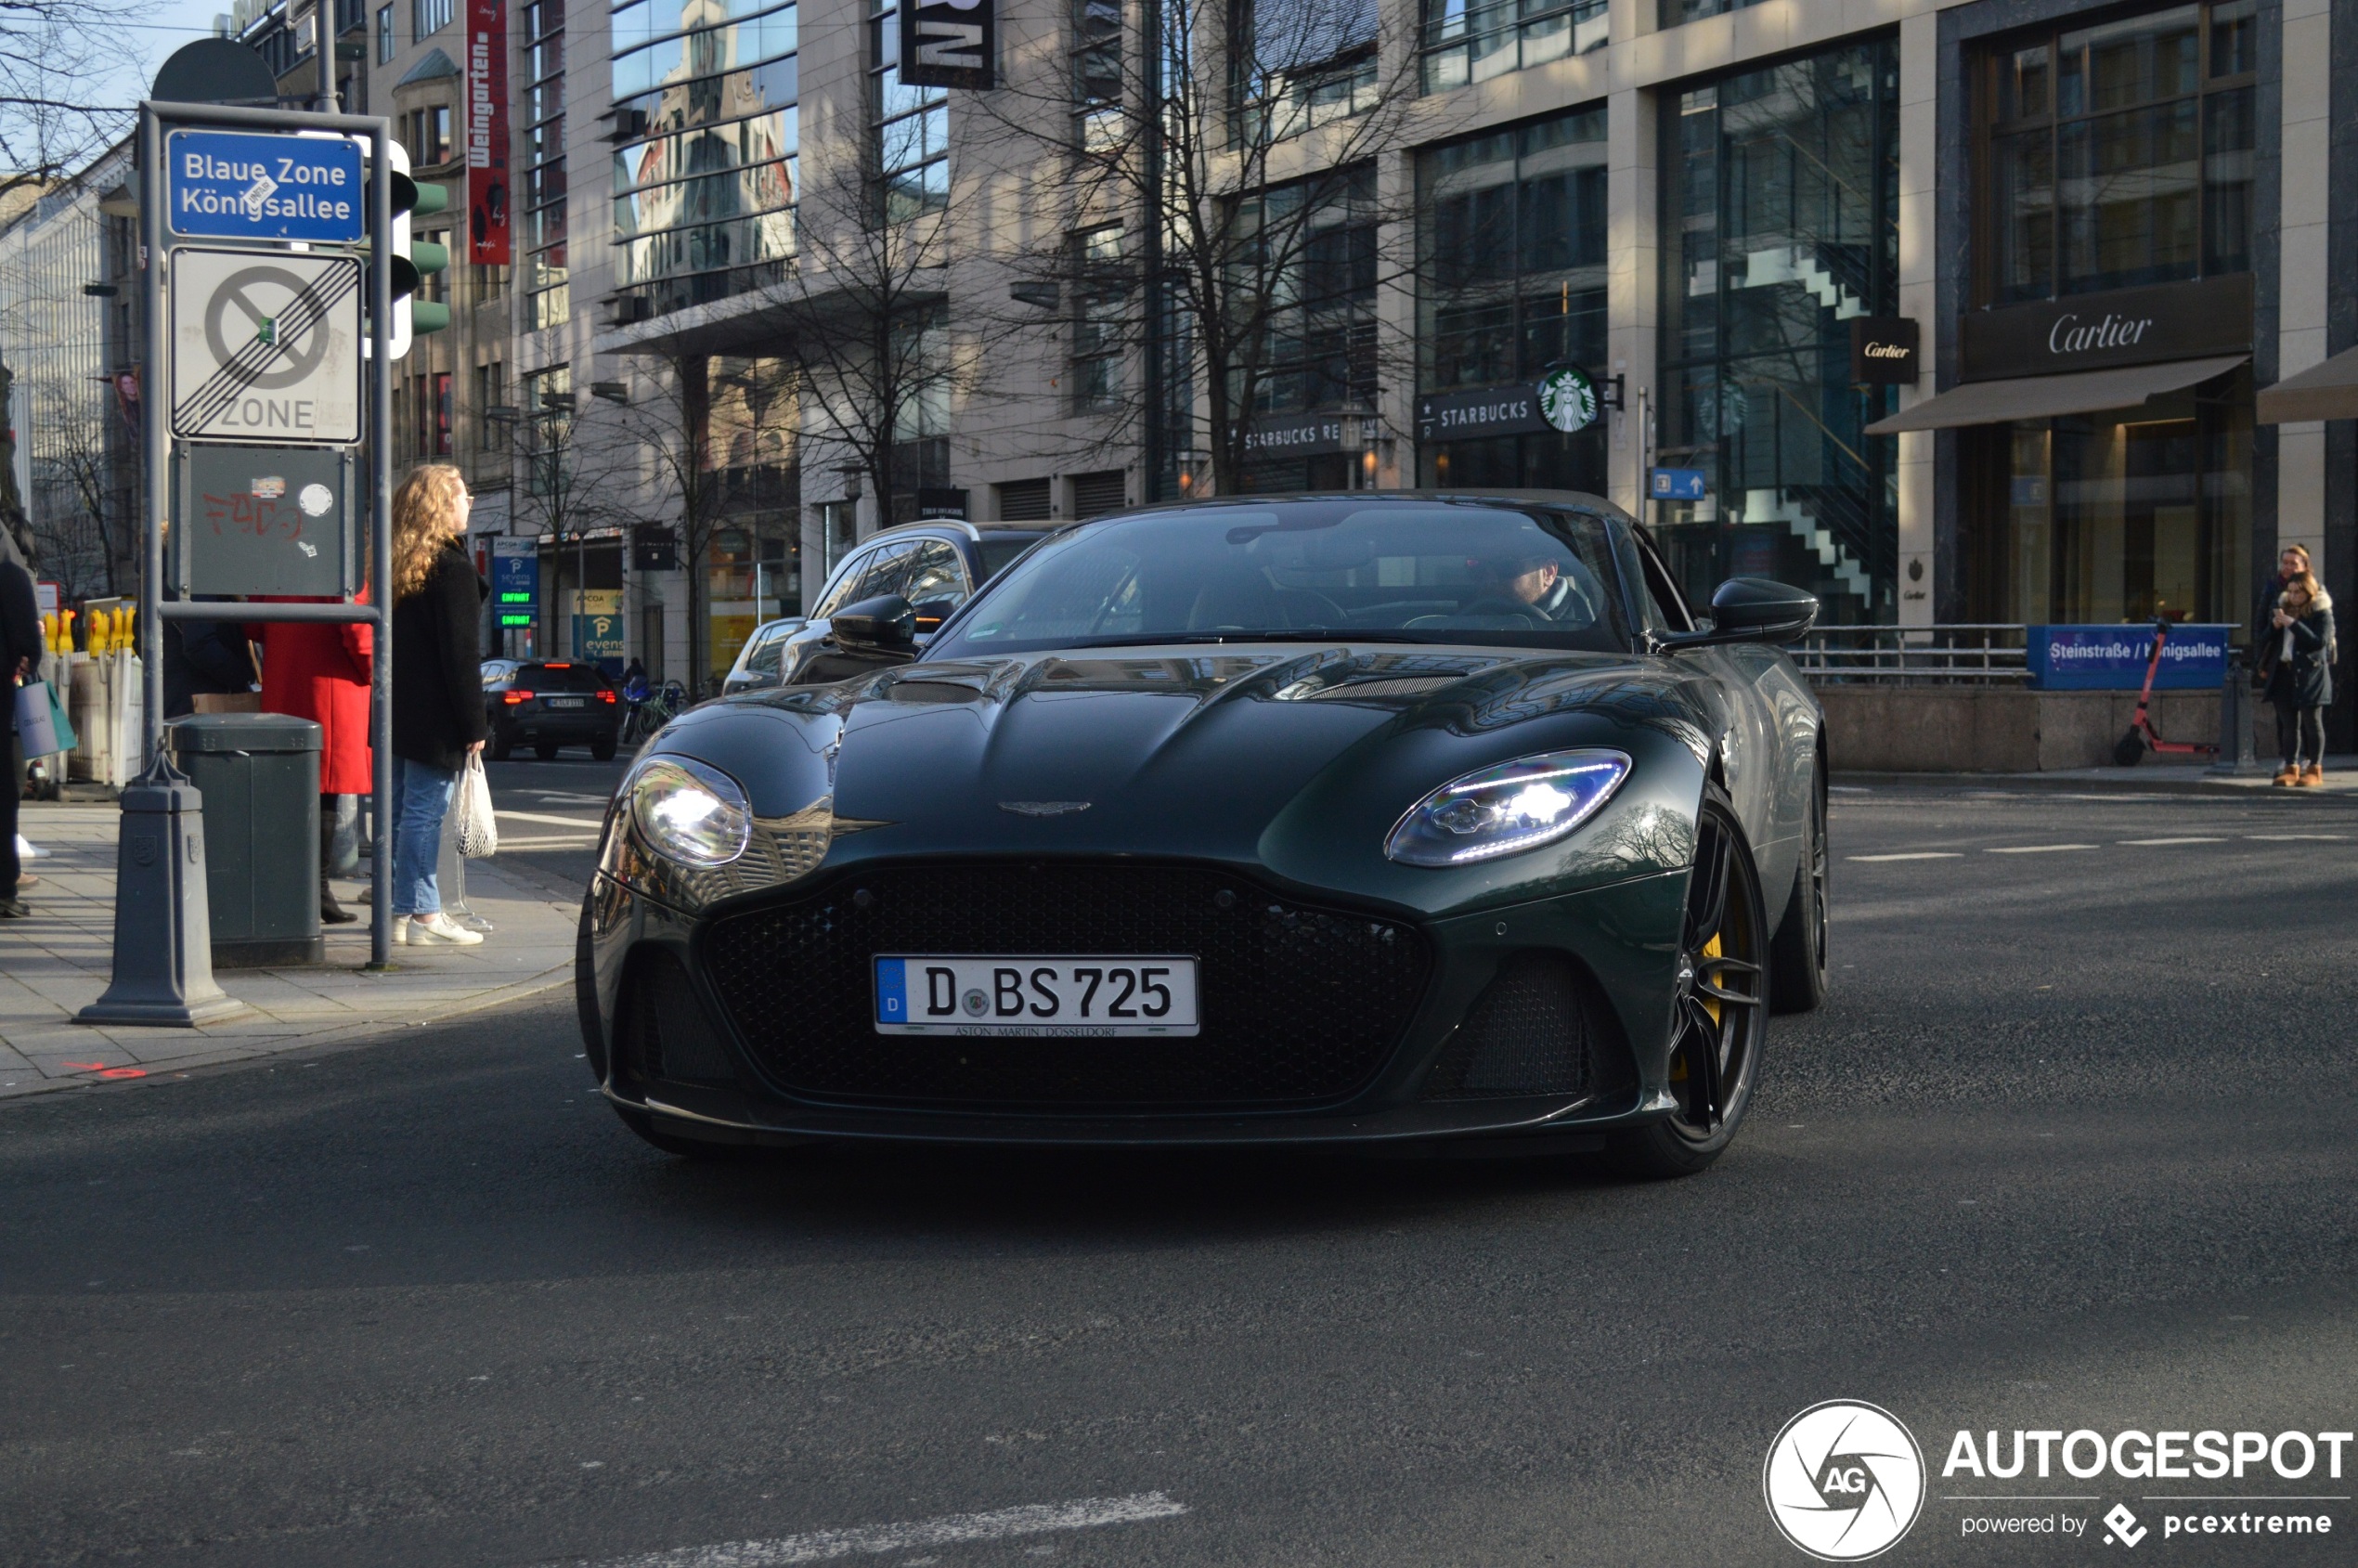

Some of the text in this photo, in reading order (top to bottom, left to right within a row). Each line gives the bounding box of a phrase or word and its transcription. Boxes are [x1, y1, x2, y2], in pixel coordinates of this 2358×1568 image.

[186, 153, 345, 186] Blaue Zone
[182, 188, 350, 222] Königsallee
[2049, 314, 2152, 354] Cartier
[1864, 341, 1910, 359] Cartier
[221, 397, 314, 429] ZONE
[1441, 400, 1528, 427] STARBUCKS
[2050, 642, 2131, 659] Steinstraße
[887, 998, 899, 1012] D
[926, 966, 1171, 1017] D BS 725
[955, 1027, 991, 1037] ASTON
[997, 1027, 1040, 1037] MARTIN
